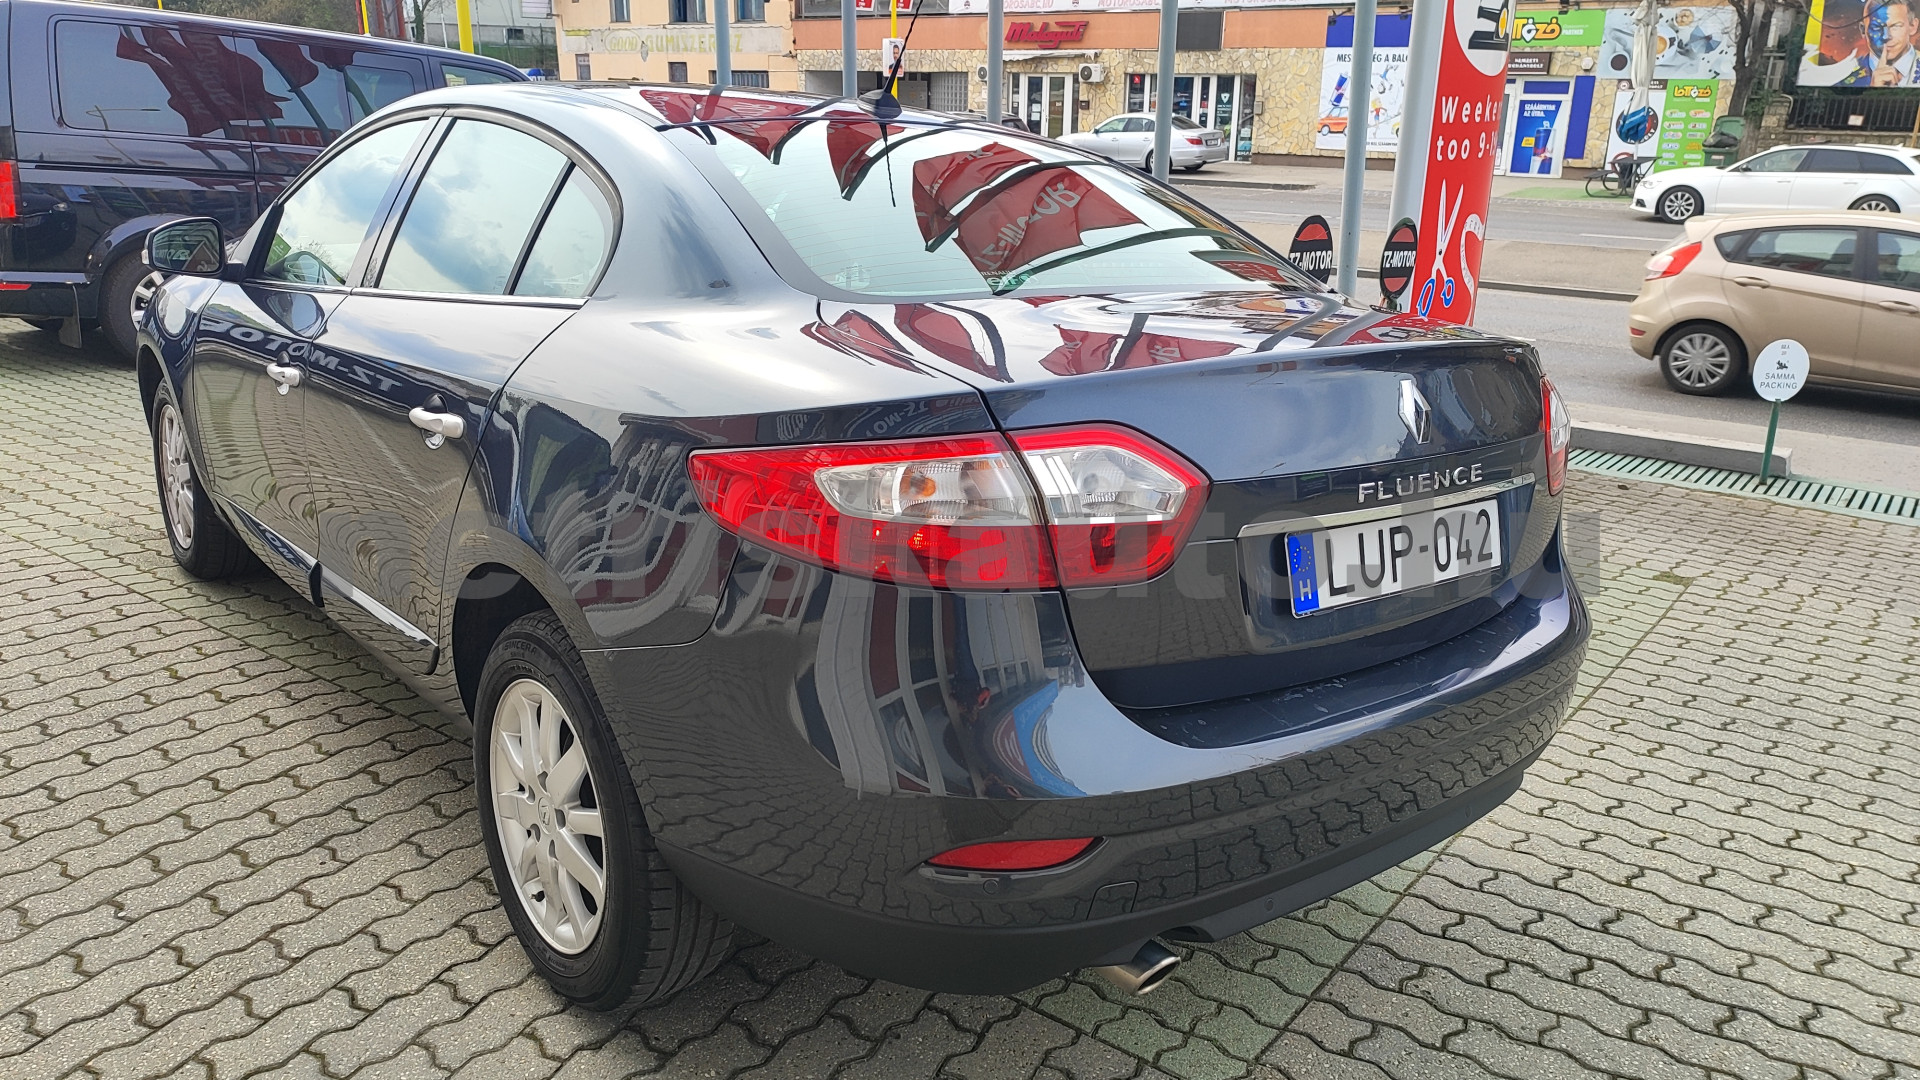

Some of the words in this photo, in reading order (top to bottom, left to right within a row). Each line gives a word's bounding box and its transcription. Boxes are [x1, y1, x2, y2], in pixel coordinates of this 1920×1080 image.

[1442, 94, 1503, 123] Weeke
[1436, 135, 1470, 161] too
[1383, 250, 1416, 268] TZ-MOTOR
[1760, 381, 1798, 390] PACKING
[1357, 463, 1484, 503] FLUENCE
[1325, 509, 1494, 597] LUP-042
[1299, 578, 1313, 602] H
